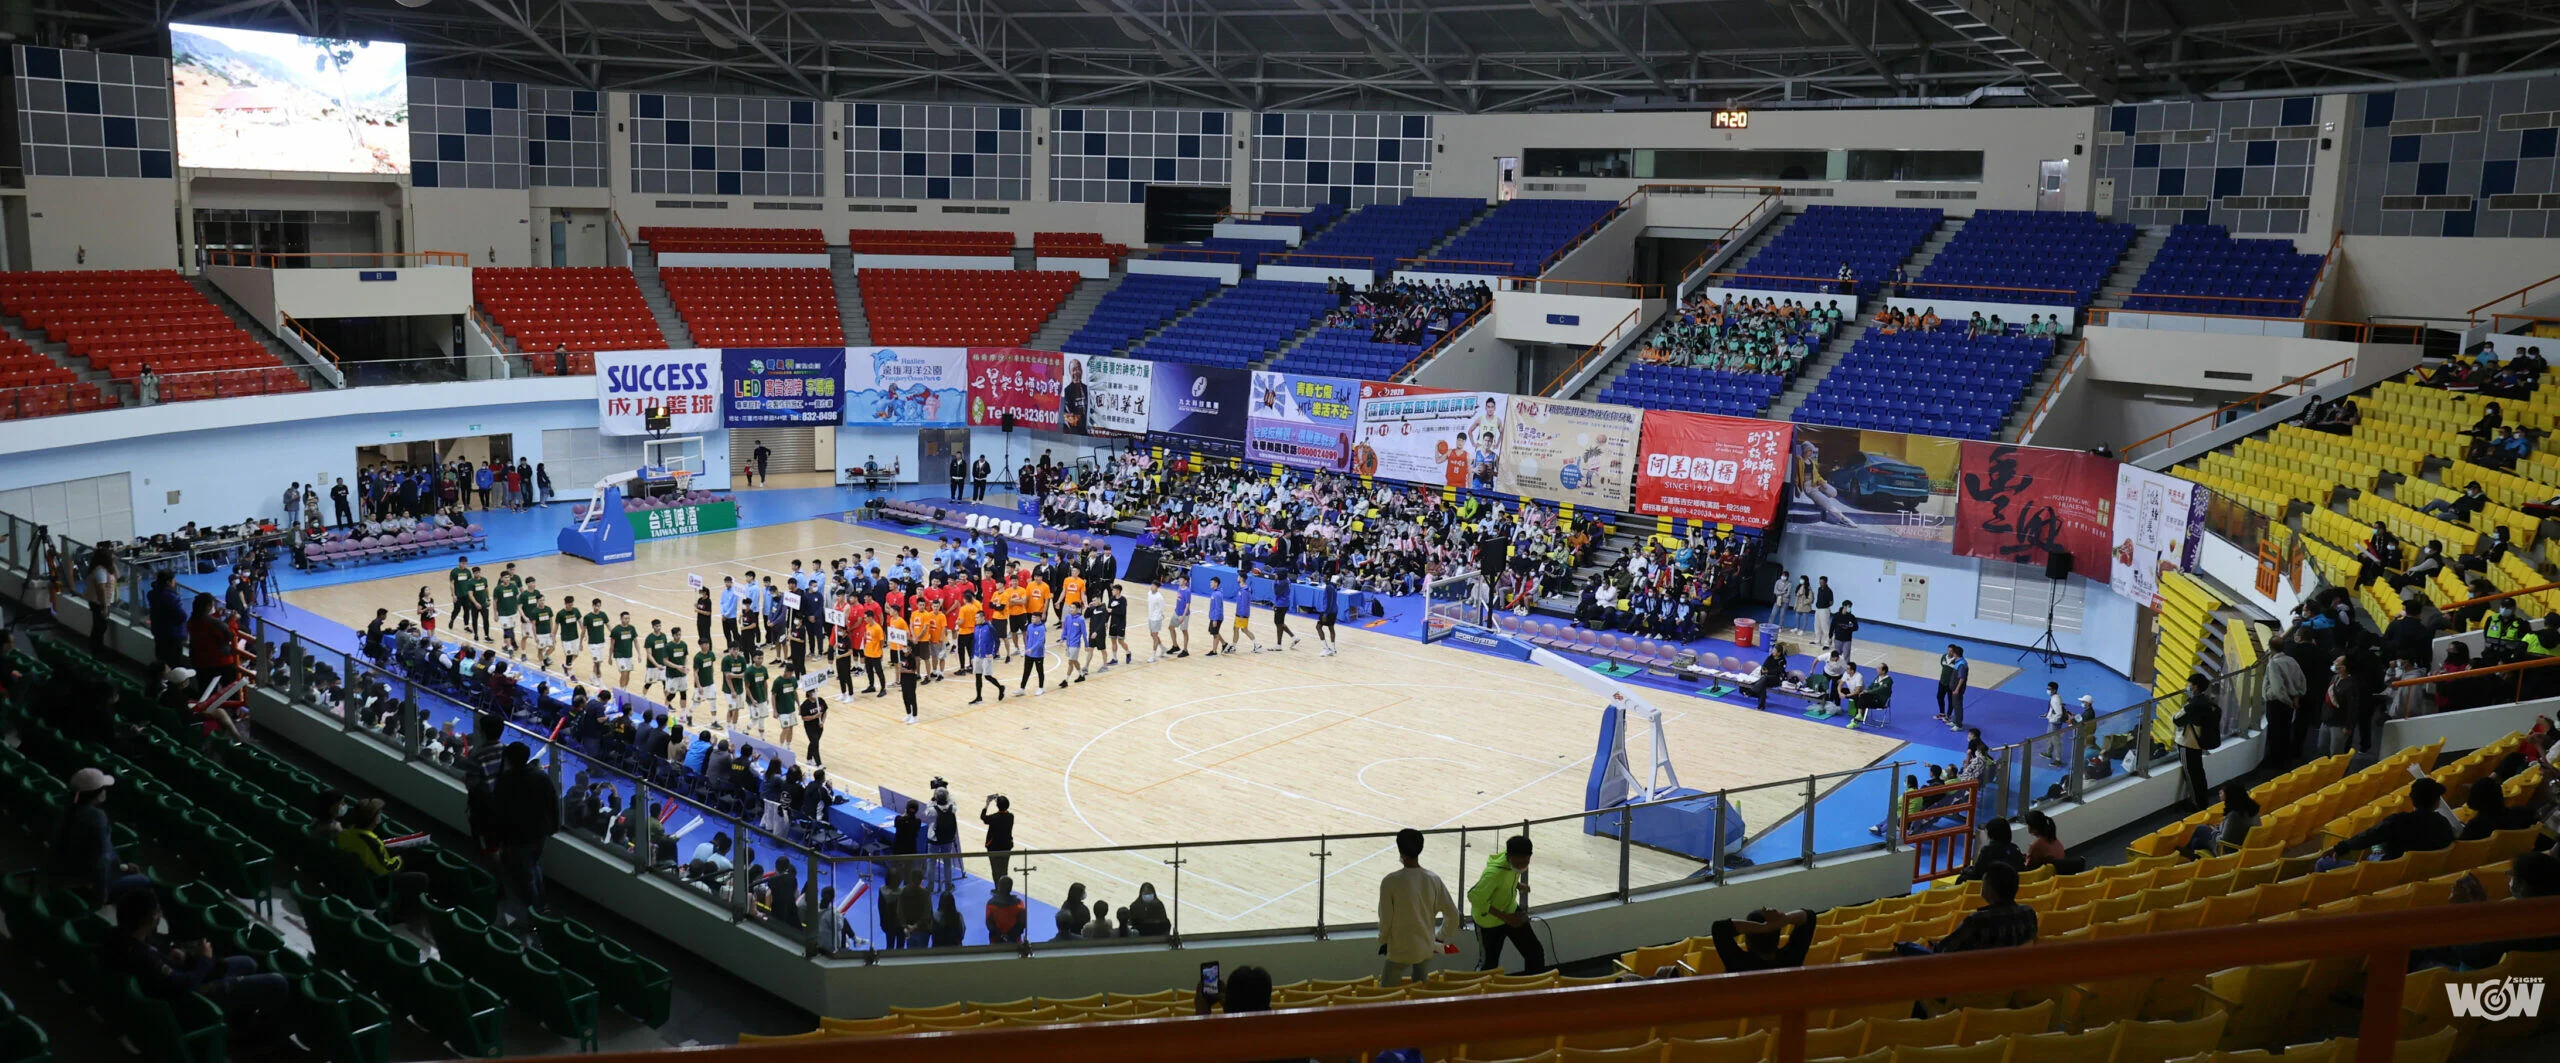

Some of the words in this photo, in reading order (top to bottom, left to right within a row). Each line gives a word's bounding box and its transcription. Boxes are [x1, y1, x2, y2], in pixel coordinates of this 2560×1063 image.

[1716, 111, 1748, 127] 1920
[608, 363, 708, 393] SUCCESS
[883, 365, 942, 376] 遠雄海洋公園
[734, 379, 762, 398] LED
[764, 379, 804, 397] 廣告招牌
[1390, 388, 1405, 396] 2020
[608, 394, 713, 416] 成功籃球
[1664, 482, 1689, 491] SINCE
[1692, 484, 1713, 494] 1970
[651, 528, 679, 538] TAIWAN
[679, 524, 699, 534] BEER
